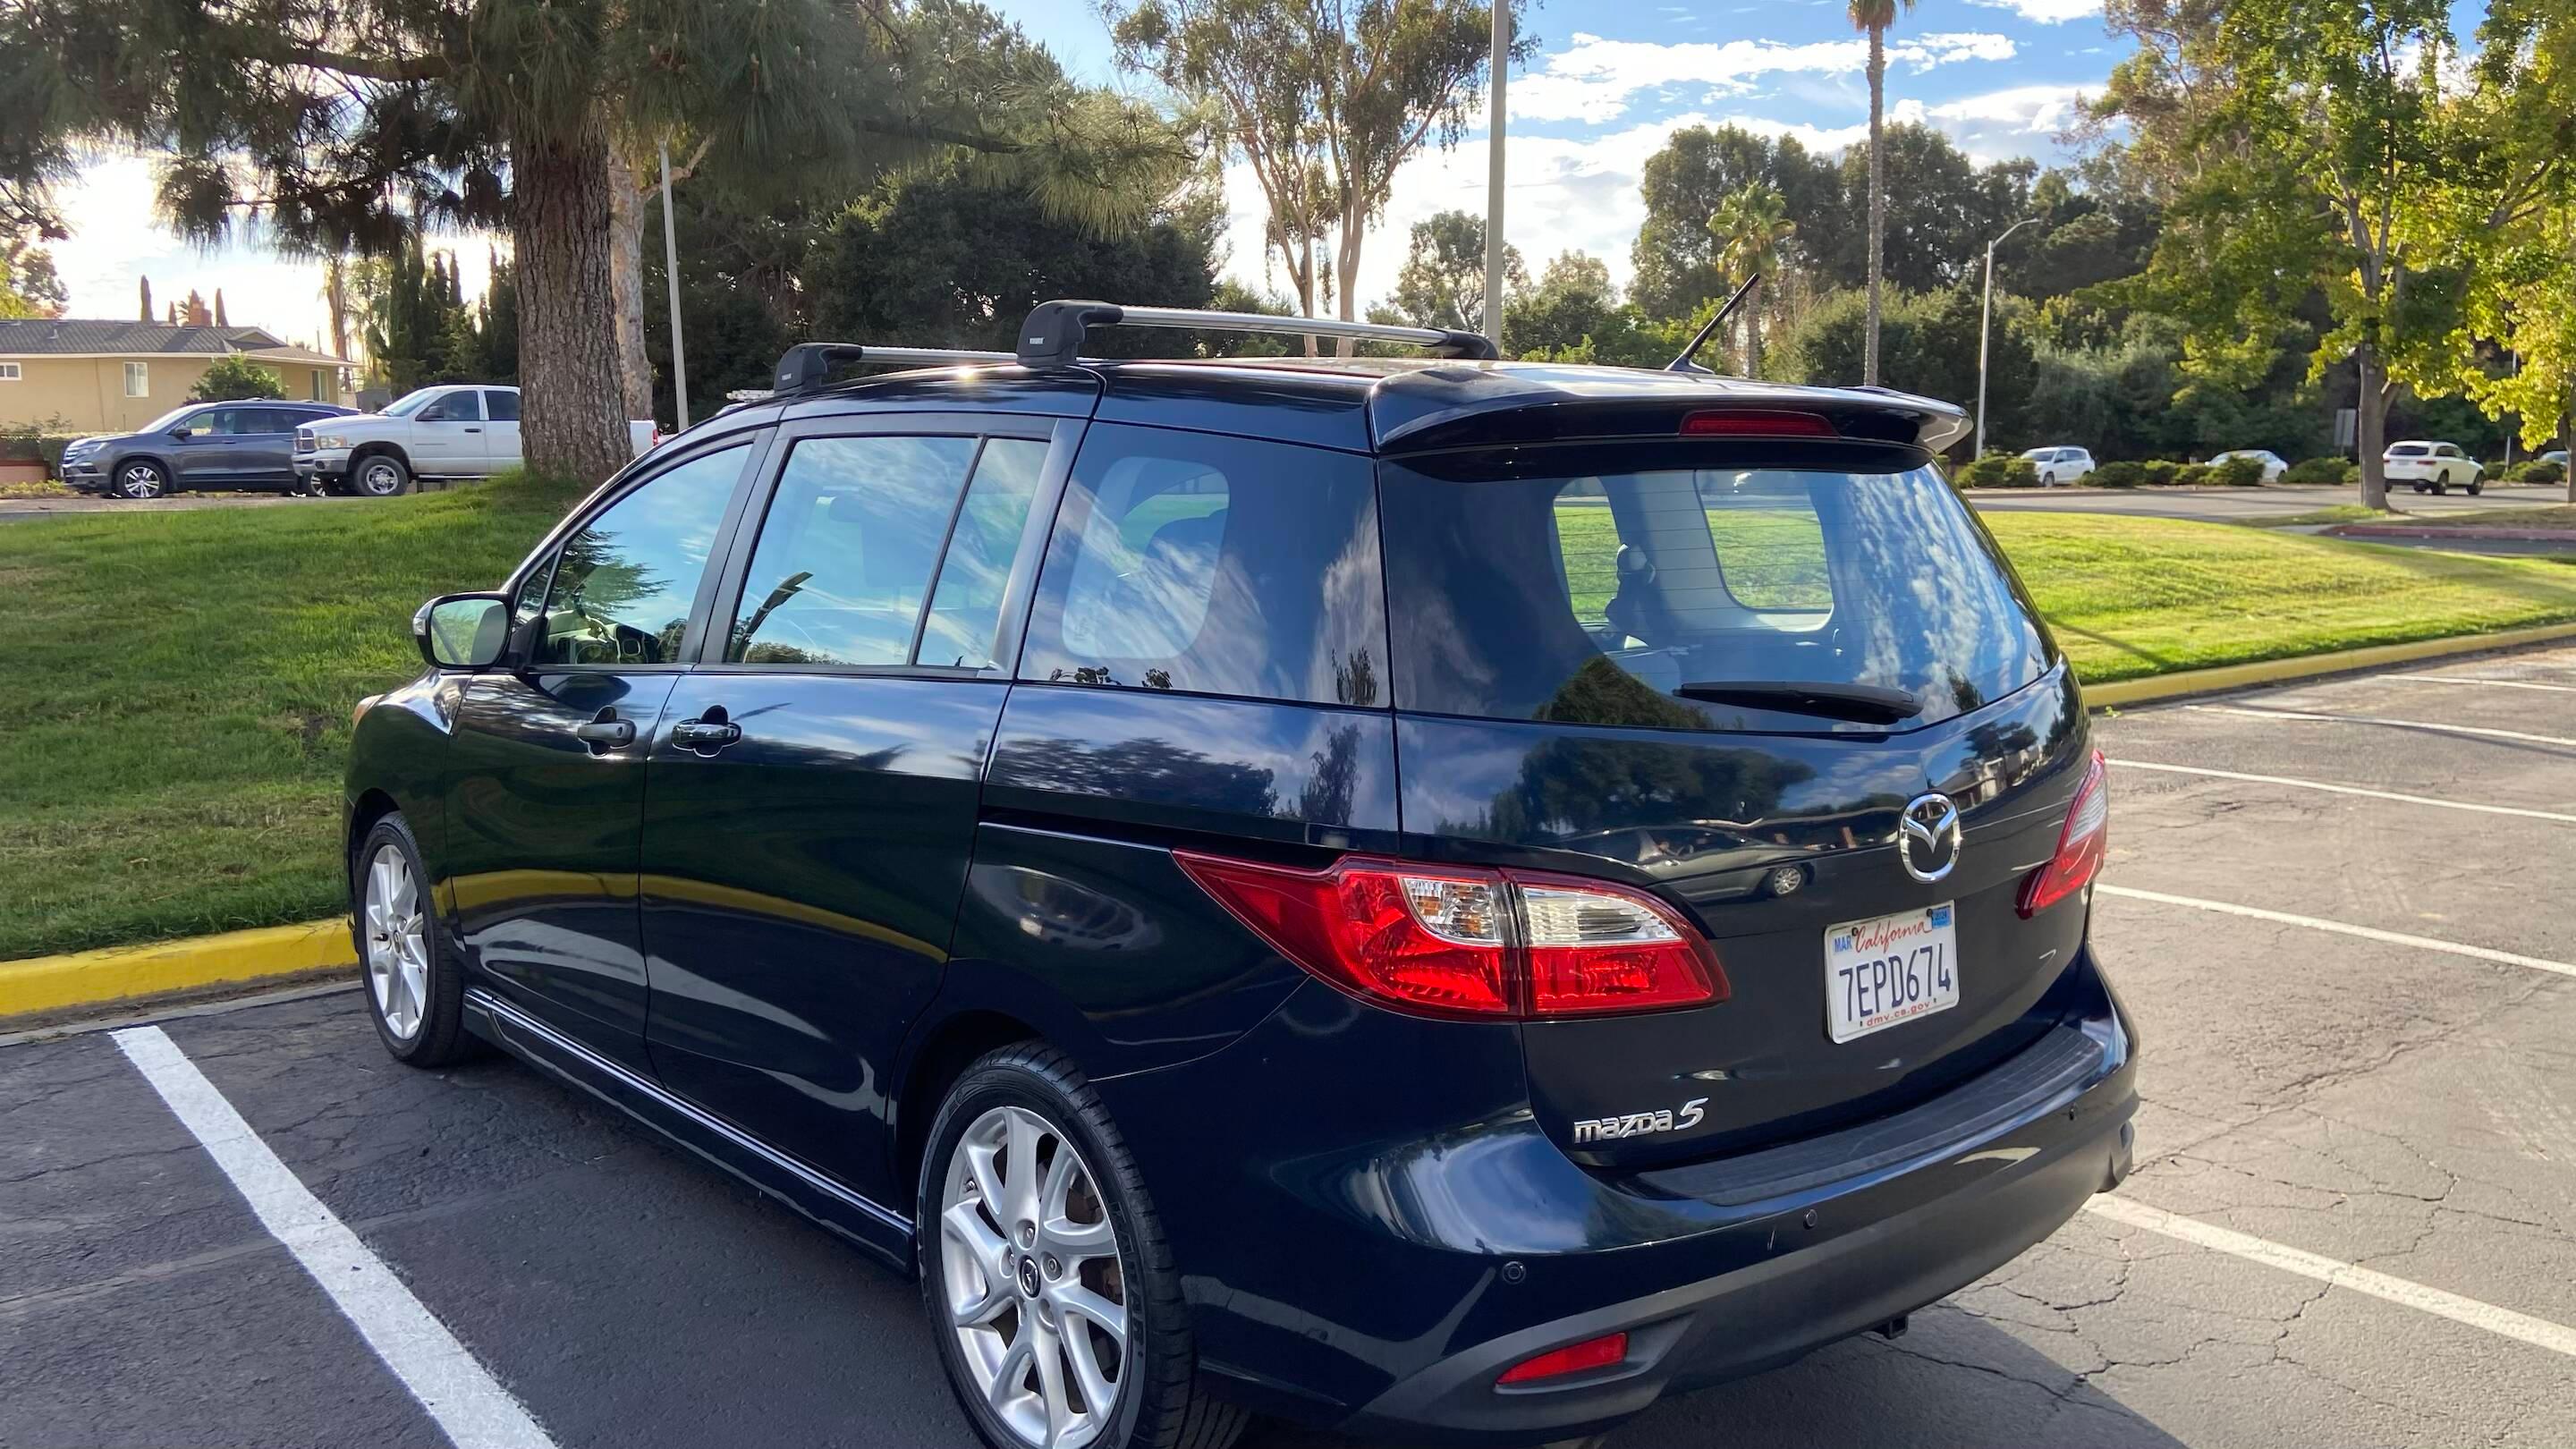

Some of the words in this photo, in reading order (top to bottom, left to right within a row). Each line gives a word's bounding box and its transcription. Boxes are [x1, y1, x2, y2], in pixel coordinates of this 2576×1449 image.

[1835, 936, 1852, 953] MAR
[1854, 919, 1932, 953] California
[1839, 943, 1952, 1021] 7EPD674
[1867, 1000, 1930, 1027] dmv.ca.gov
